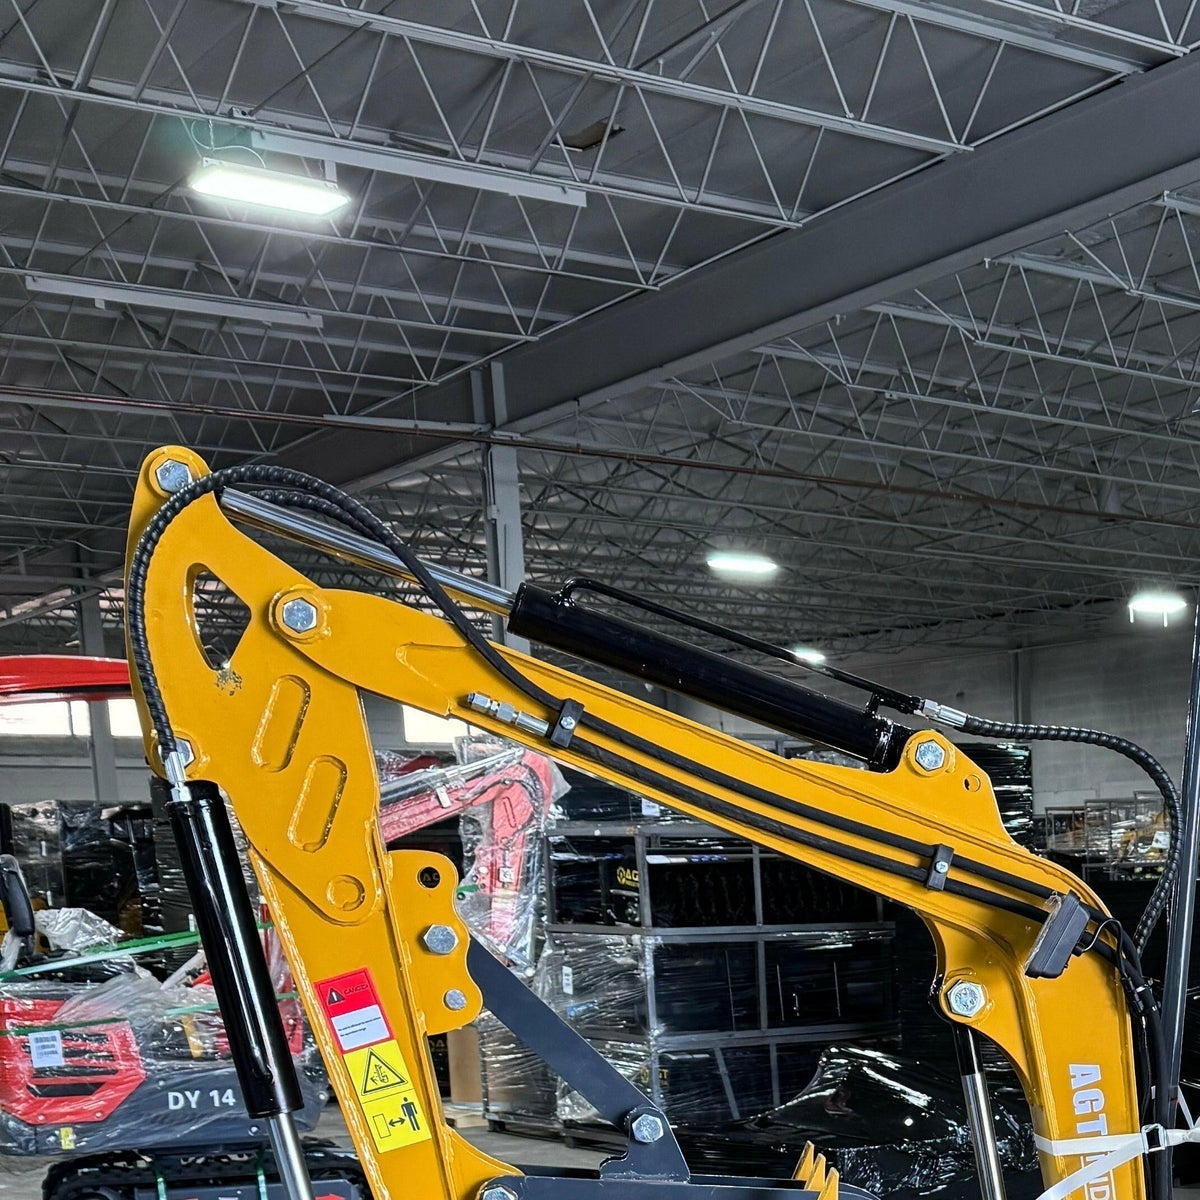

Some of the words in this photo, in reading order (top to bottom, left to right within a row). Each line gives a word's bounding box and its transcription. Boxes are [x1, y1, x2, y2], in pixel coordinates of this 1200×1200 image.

[167, 1090, 200, 1110] DY
[209, 1088, 236, 1107] 14
[1069, 1063, 1108, 1136] AGT
